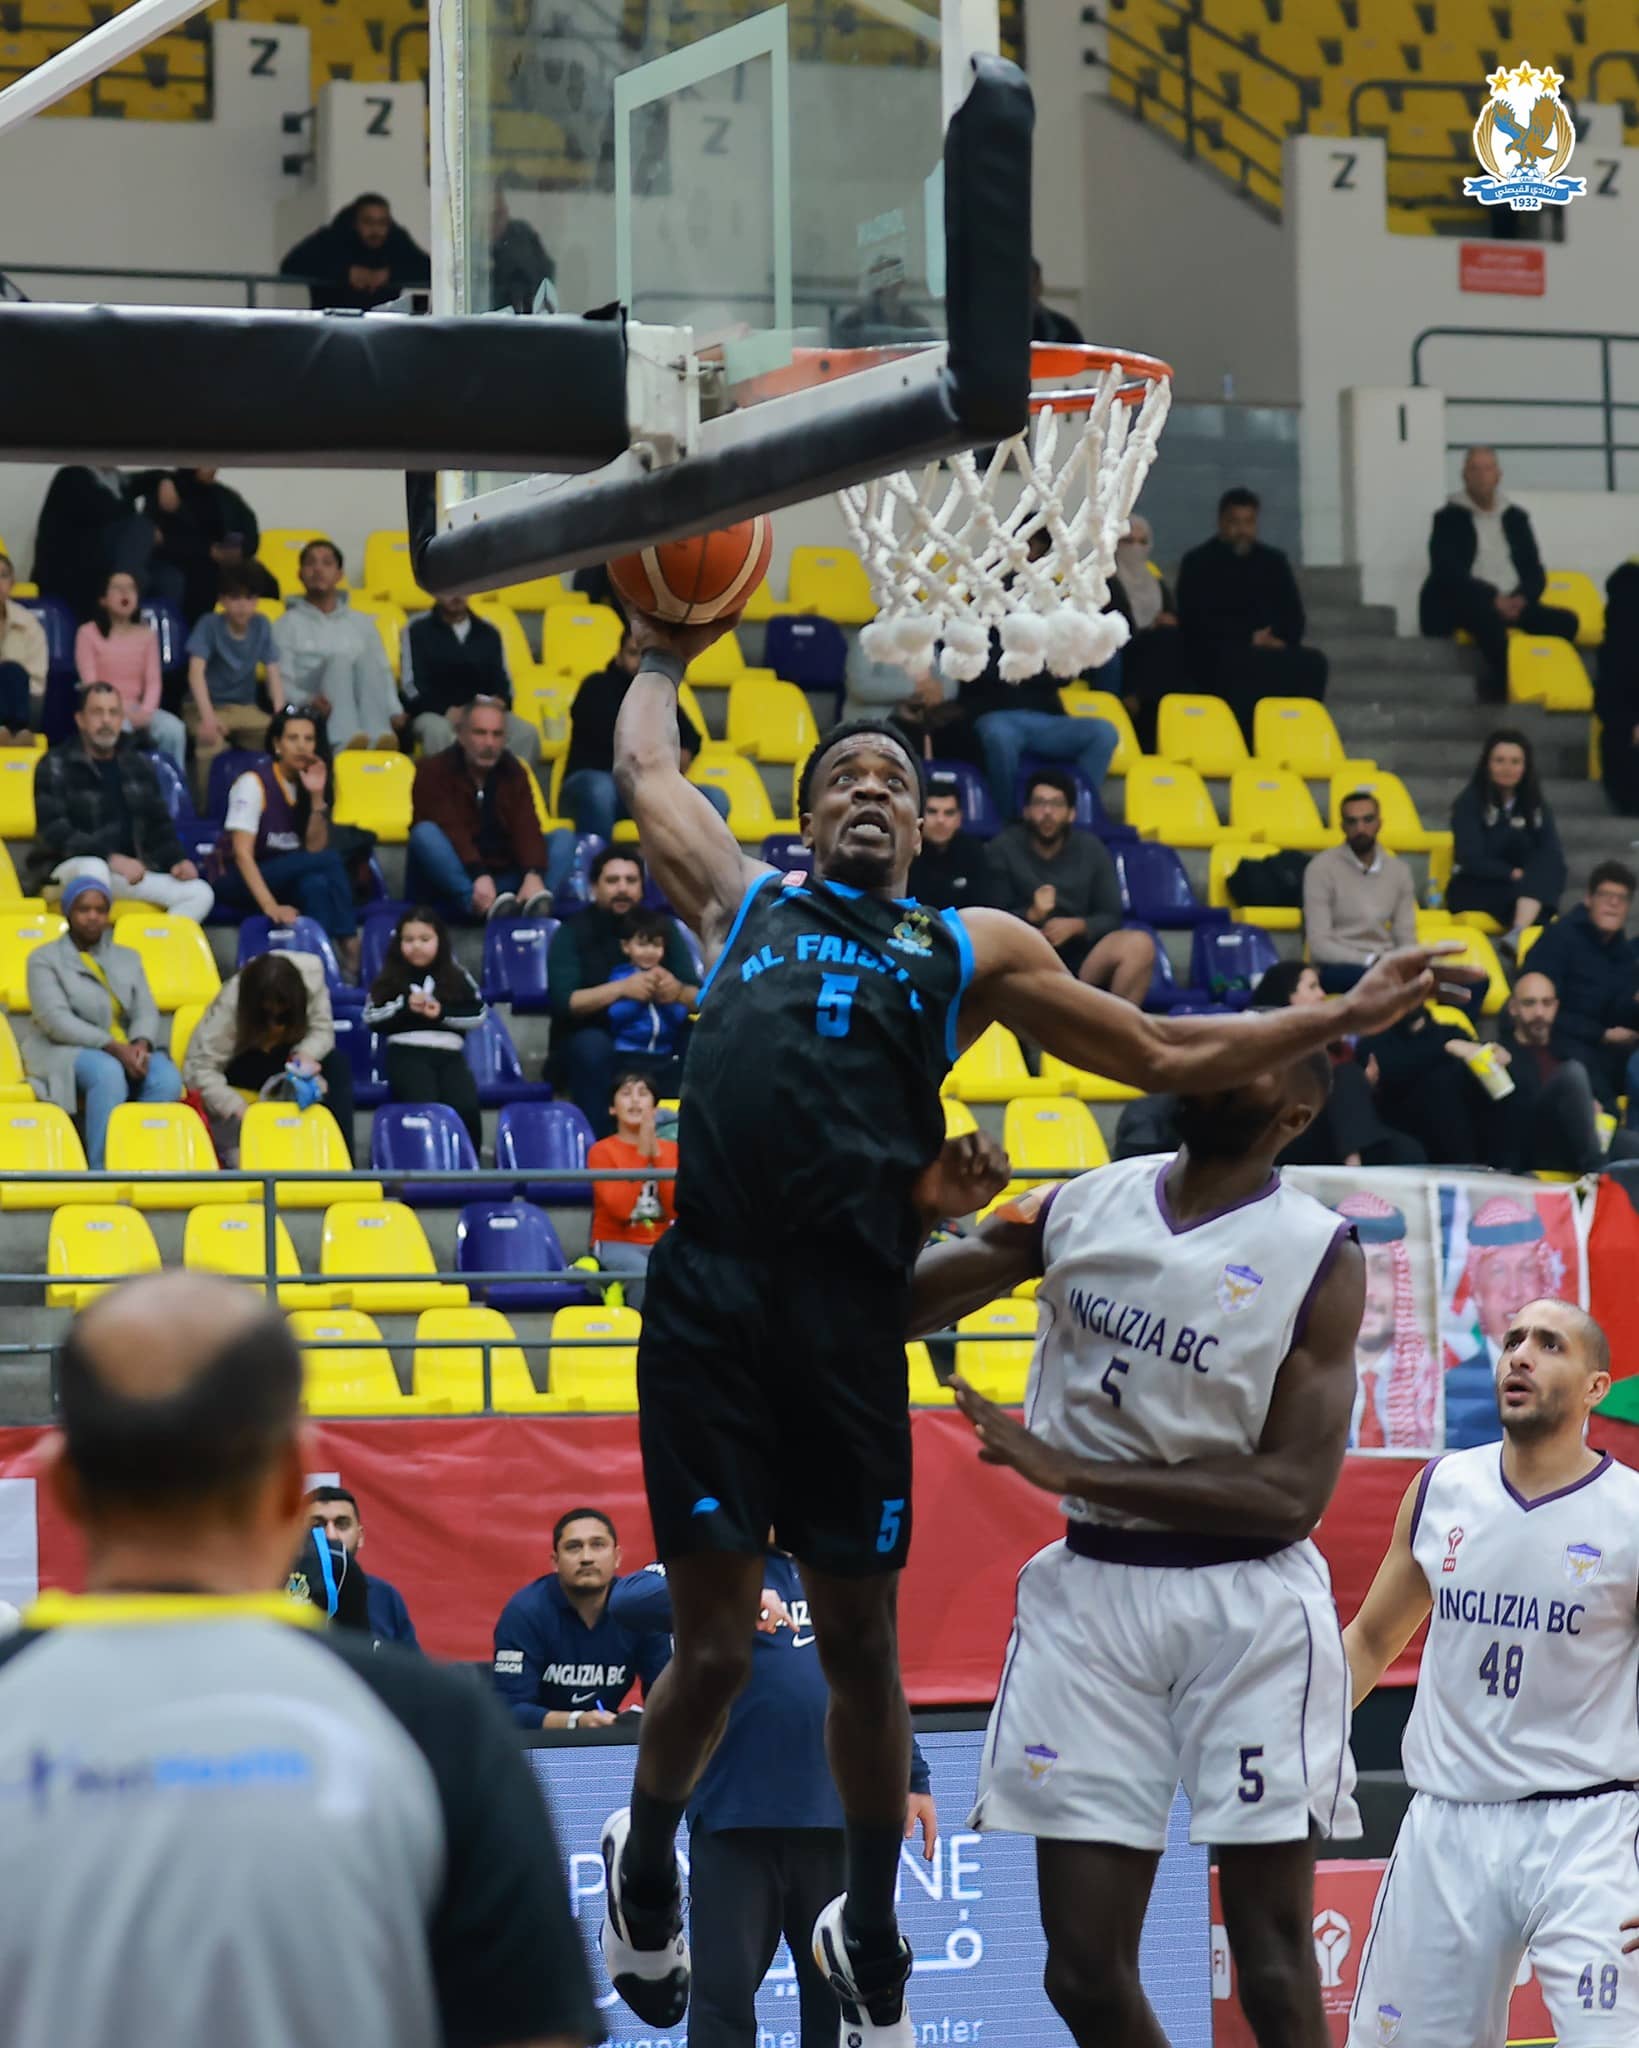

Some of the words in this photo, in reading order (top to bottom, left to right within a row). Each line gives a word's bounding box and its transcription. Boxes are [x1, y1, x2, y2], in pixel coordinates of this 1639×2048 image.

[741, 944, 785, 983] AL
[816, 972, 859, 1038] 5
[1070, 1287, 1167, 1357] INGLIZIA
[1170, 1326, 1219, 1374] BC
[1101, 1356, 1129, 1409] 5
[876, 1498, 904, 1553] 5
[1439, 1587, 1539, 1631] INGLIZIA
[1547, 1600, 1585, 1635] BC
[542, 1662, 604, 1686] INGLIZIA
[606, 1664, 626, 1686] BC
[1479, 1641, 1524, 1698] 48
[1238, 1746, 1264, 1803] 5
[1577, 1963, 1618, 2010] 48
